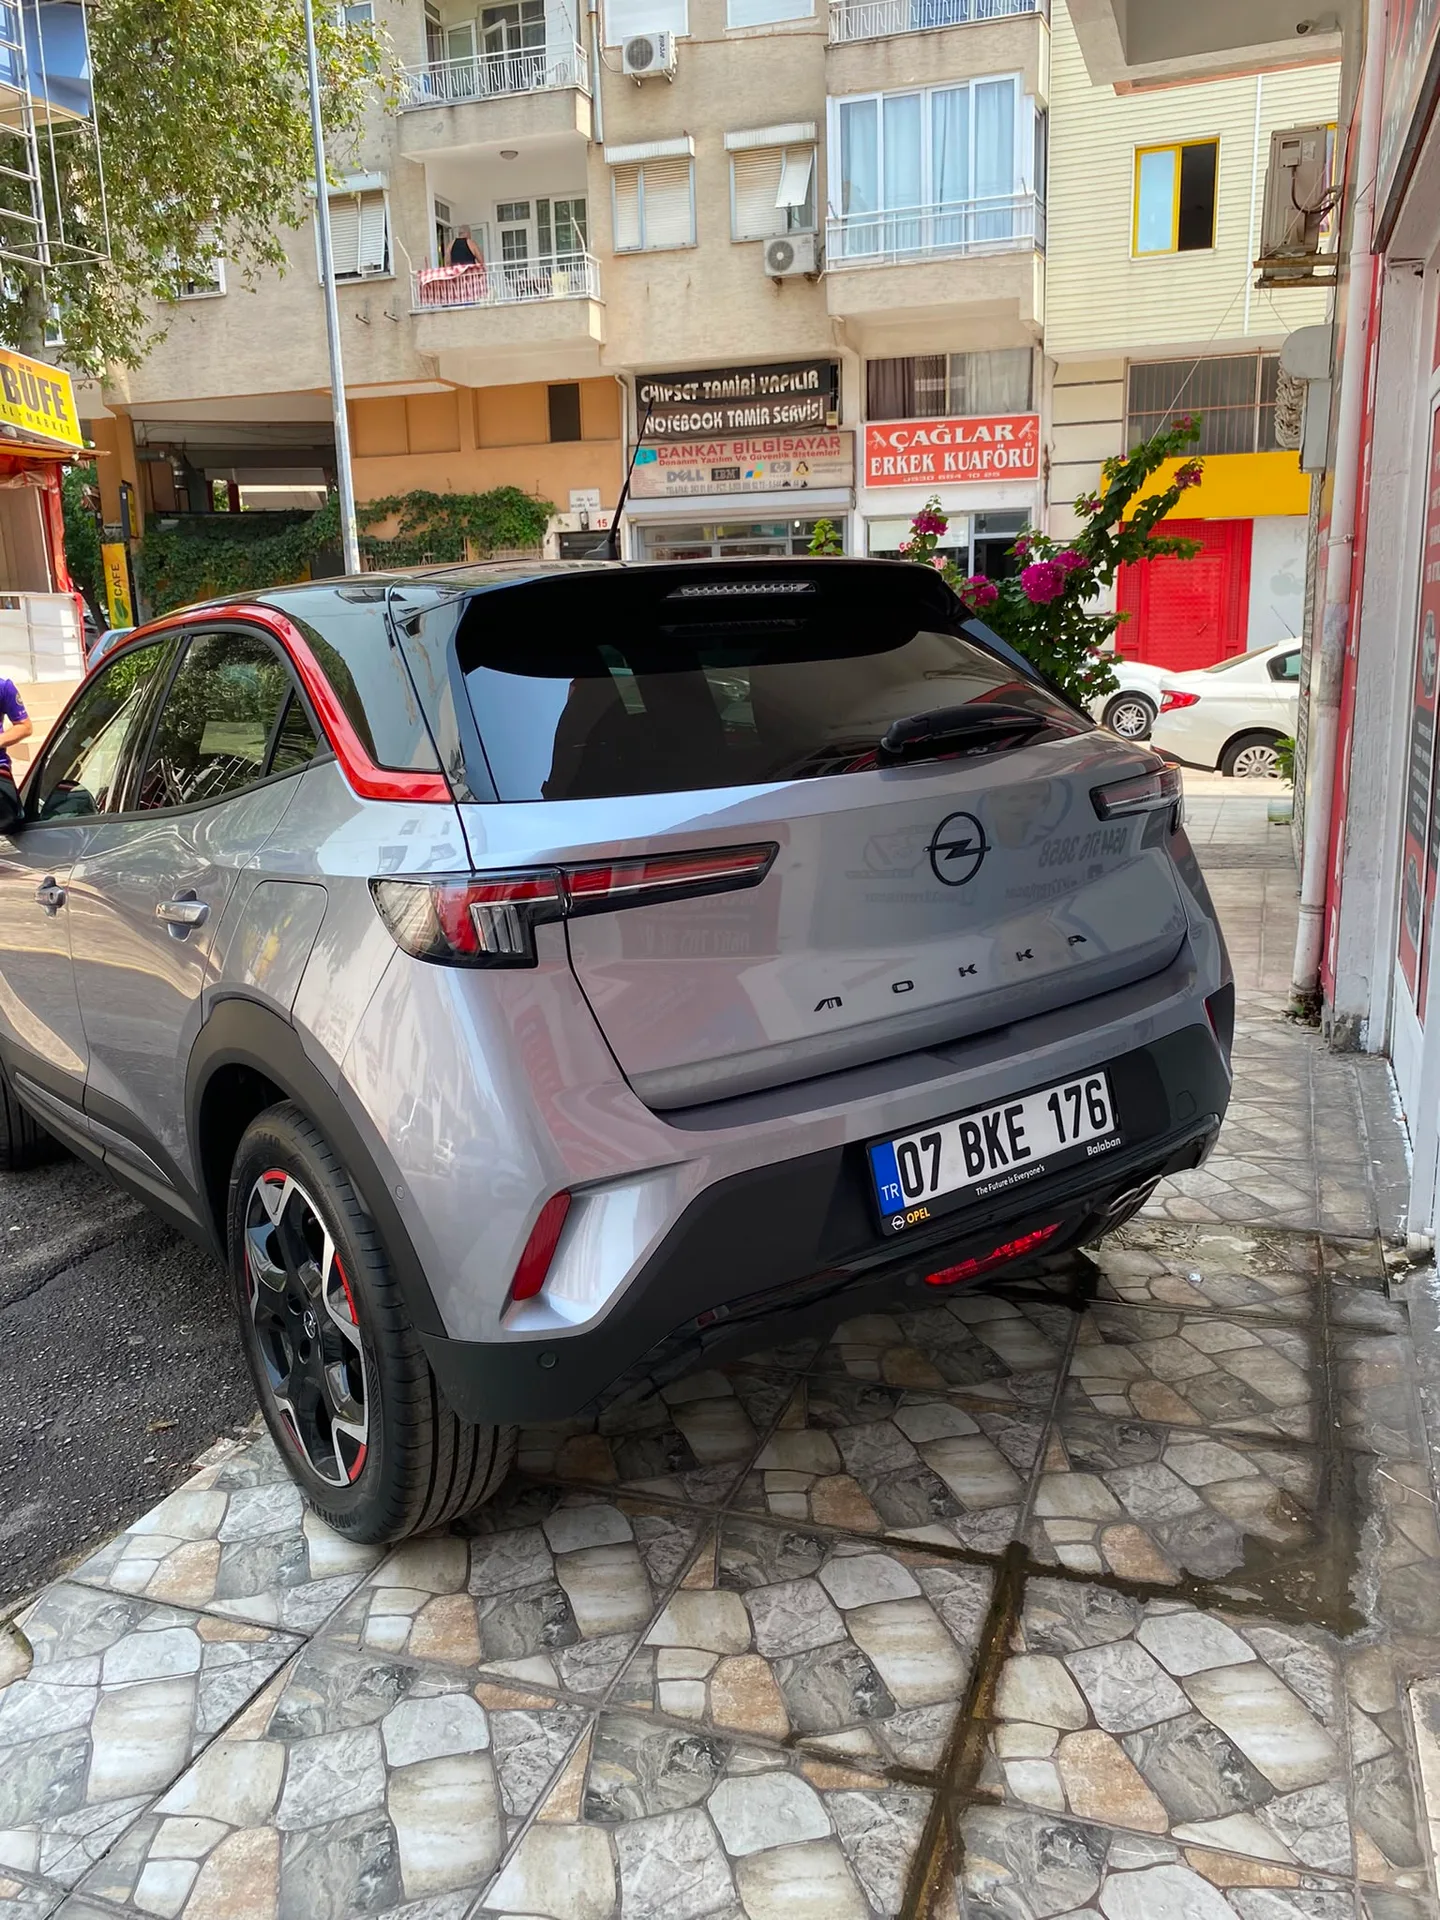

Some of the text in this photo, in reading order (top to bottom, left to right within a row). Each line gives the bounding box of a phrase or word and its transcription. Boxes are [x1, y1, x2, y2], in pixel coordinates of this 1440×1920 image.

[0, 362, 69, 422] BÜFE
[640, 369, 819, 403] CHIPSET TAMİRİ YAPILIR
[644, 397, 824, 434] NOTEBOOK TAMİR SERVİSİ
[657, 435, 841, 459] CANKAT BİLGİSAYAR
[736, 454, 748, 462] Ve
[749, 450, 790, 462] Güvenlik
[792, 448, 841, 459] Sistemleri
[889, 423, 1015, 453] ÇAĞLAR
[666, 470, 704, 483] DELL
[713, 469, 738, 480] IBM
[870, 441, 1036, 477] ERKEK KUAFÖRÜ
[597, 518, 608, 528] 15
[111, 563, 123, 597] CAFE
[813, 934, 1087, 1012] MOKKA
[881, 1078, 1108, 1201] TR 07 BKE 176
[1086, 1135, 1122, 1156] Balaban
[975, 1163, 1046, 1197] The Future is Everyone's
[906, 1206, 931, 1224] OPEL
